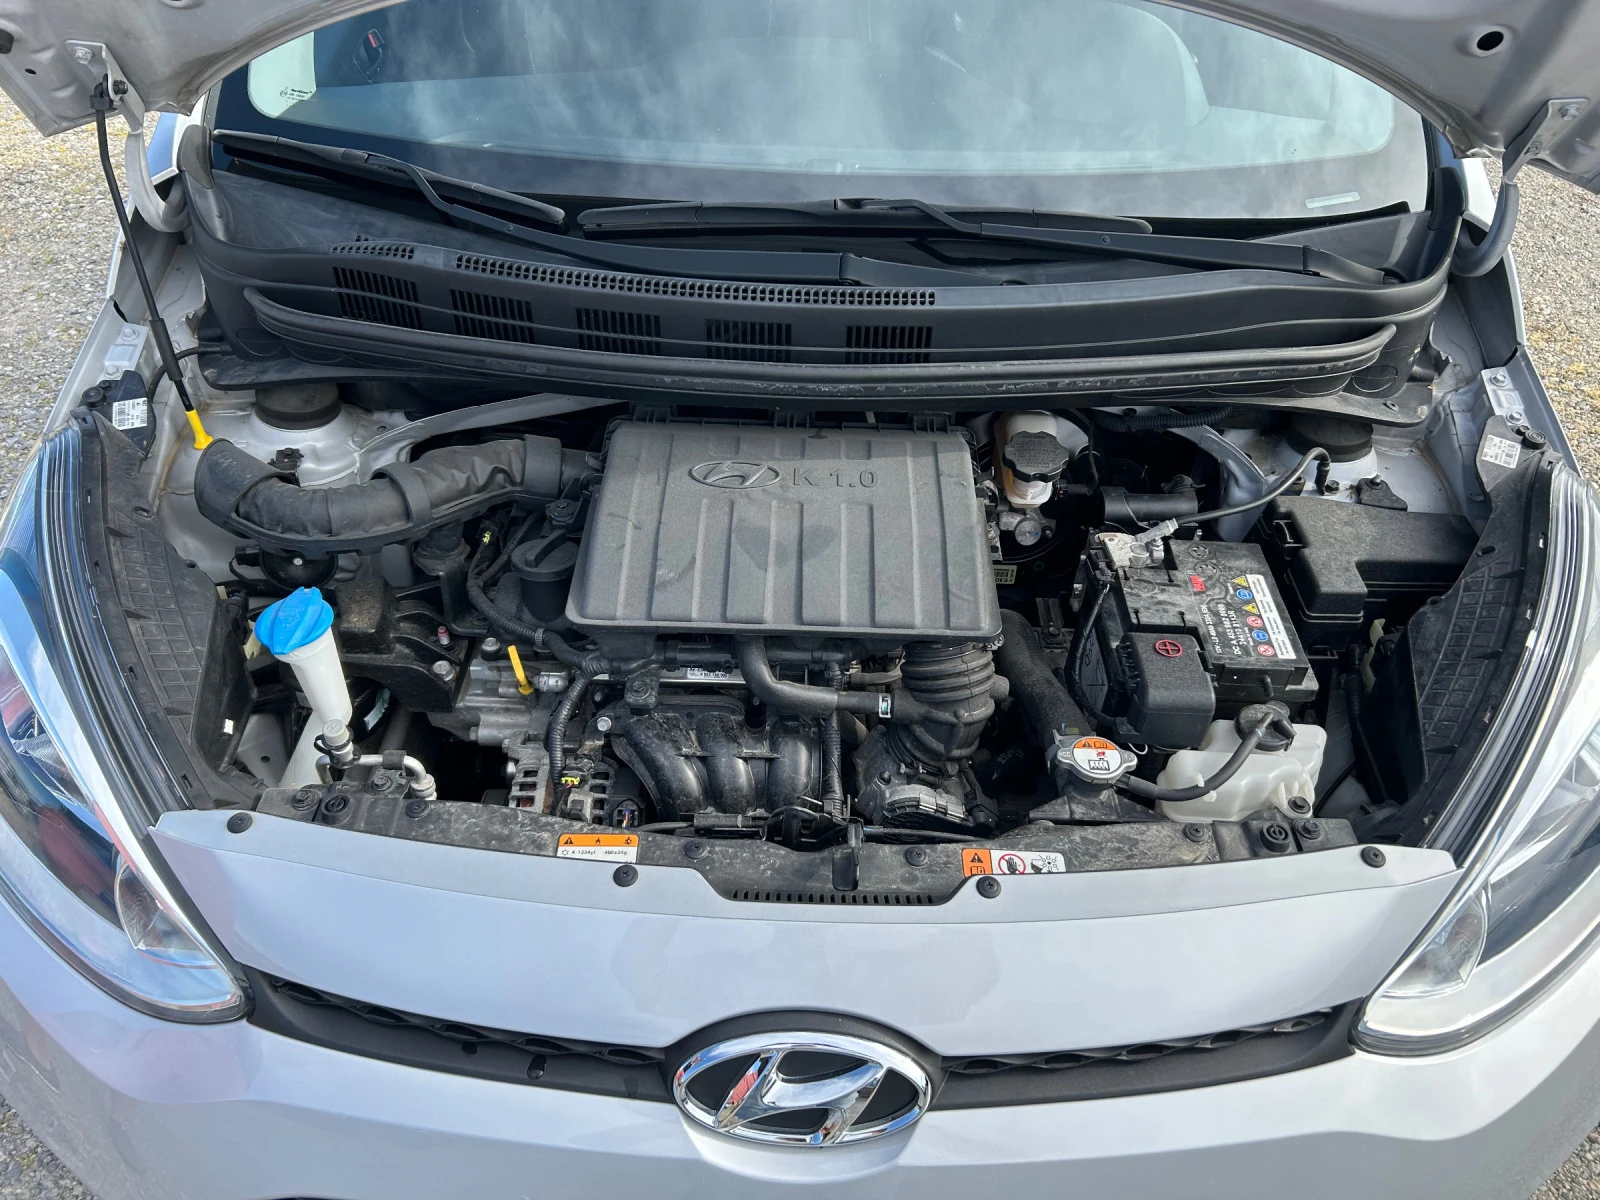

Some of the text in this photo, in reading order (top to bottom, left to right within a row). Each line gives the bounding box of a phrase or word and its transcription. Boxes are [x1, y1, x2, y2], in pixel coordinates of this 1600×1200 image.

[793, 467, 880, 488] K 1.0
[1232, 645, 1242, 655] DC
